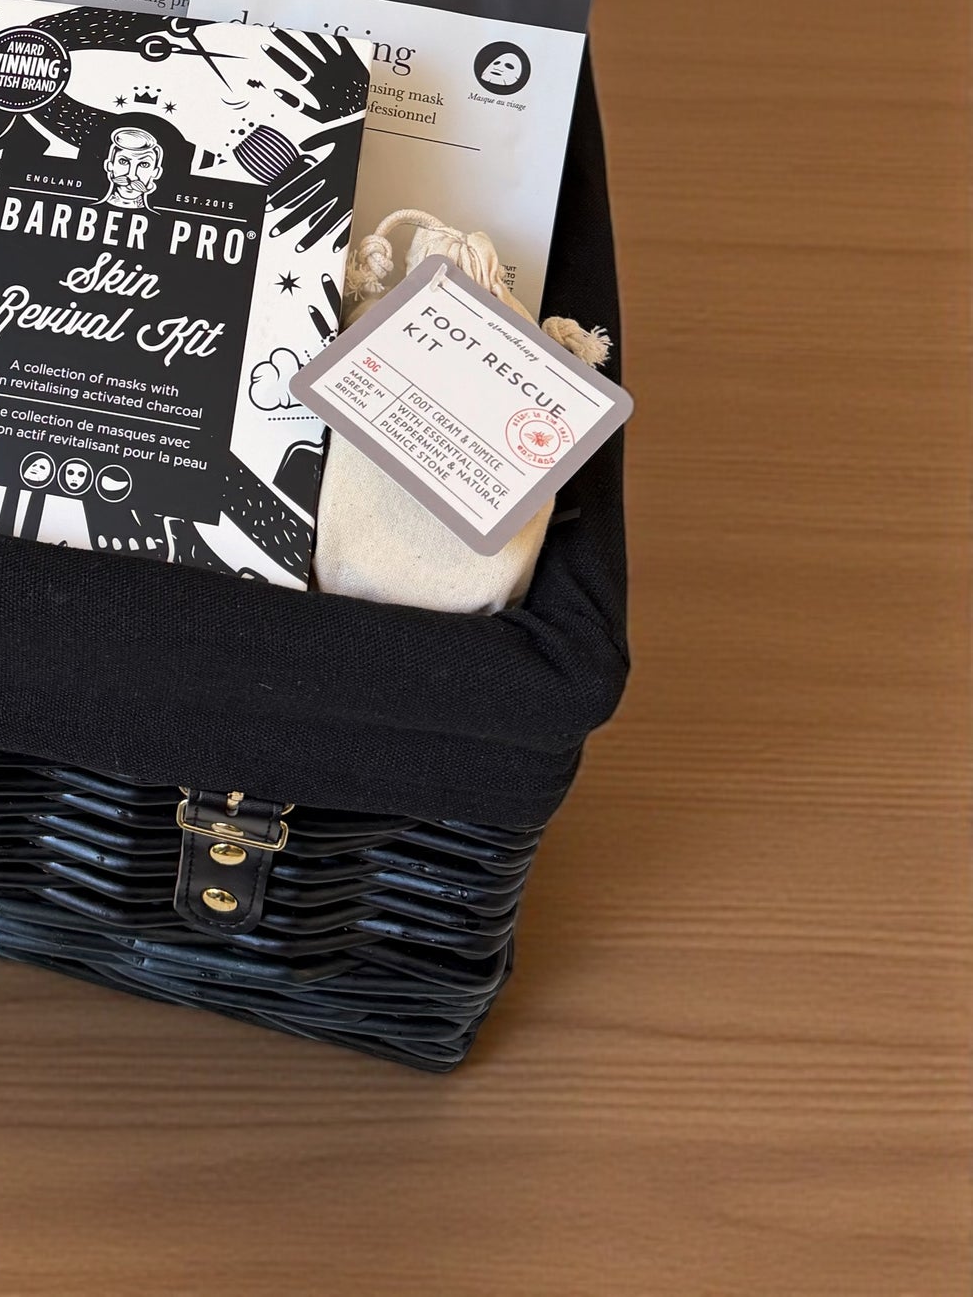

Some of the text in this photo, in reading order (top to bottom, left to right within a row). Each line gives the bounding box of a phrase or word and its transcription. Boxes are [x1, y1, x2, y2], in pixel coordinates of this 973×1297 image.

[7, 41, 44, 56] AWARD
[21, 77, 56, 93] BRAND
[369, 82, 444, 106] nsing mask
[468, 92, 495, 104] Masque
[506, 100, 526, 111] visage
[25, 173, 235, 209] ENGLAND EST.2015
[0, 196, 150, 251] BARBER
[59, 252, 160, 299] Skin
[136, 316, 225, 366] Kit
[402, 322, 443, 351] KIT
[10, 360, 179, 398] A collection of masks with
[421, 306, 566, 419] FOOT RESCUE
[10, 376, 79, 399] revitalising
[82, 389, 144, 411] activated
[146, 399, 203, 420] charcoal
[334, 382, 367, 409] BRITAIN
[342, 376, 370, 398] GREAT
[349, 370, 385, 399] MADE IN
[11, 408, 73, 429] collection
[77, 419, 94, 432] de
[97, 423, 156, 444] masques
[159, 435, 191, 449] avec
[16, 426, 47, 442] actif
[48, 431, 120, 455] revitalisant
[123, 446, 155, 463] pour
[158, 450, 171, 463] la
[173, 455, 208, 471] peau
[408, 392, 504, 471] FOOT CREAM & PUMICE
[379, 420, 450, 481] PUMICE STONE
[388, 413, 501, 510] PEPPERMINT & NATURAL
[397, 405, 508, 498] WITH ESSENTIAL OIL OF
